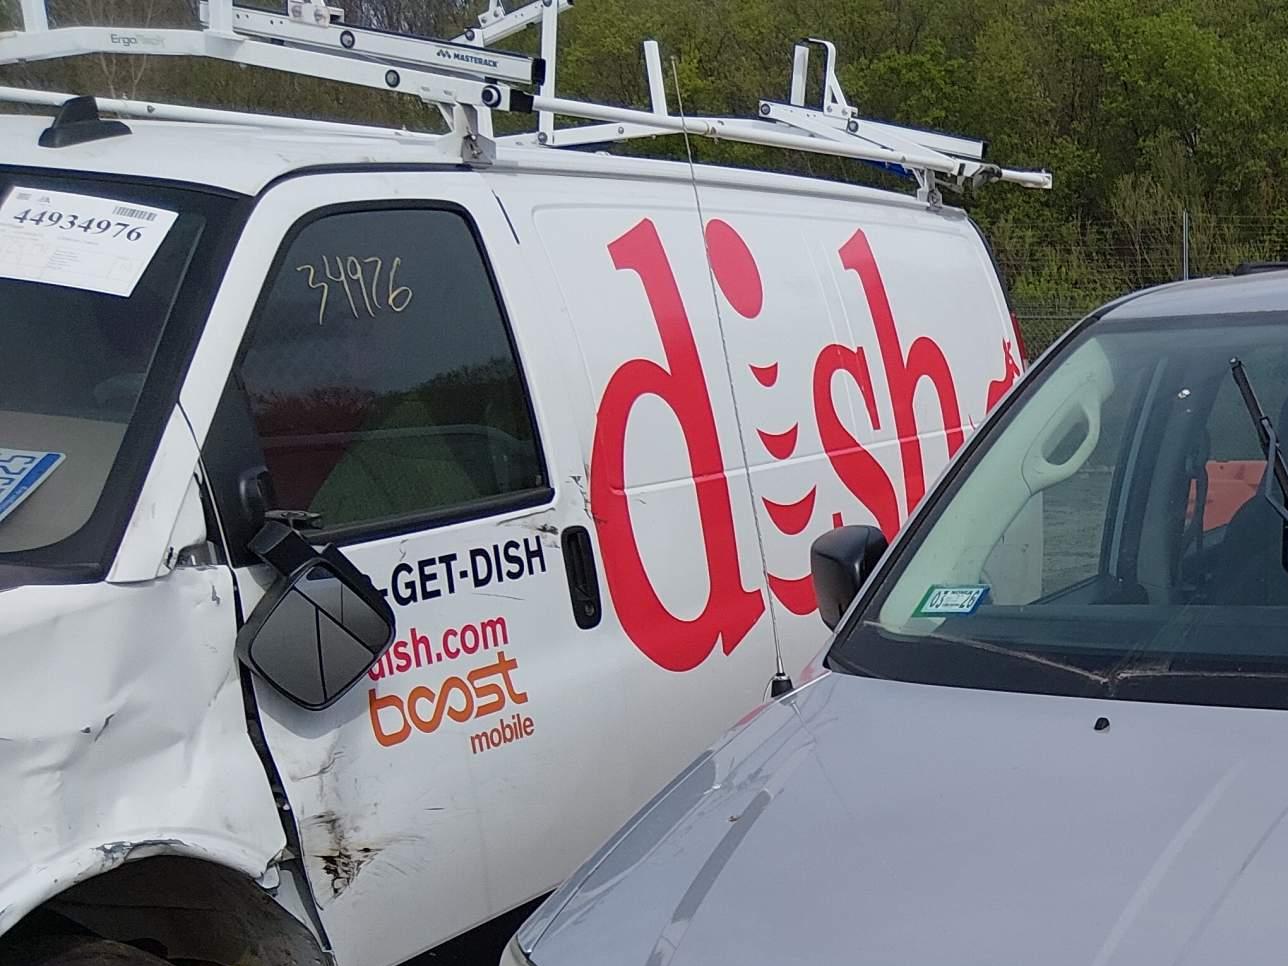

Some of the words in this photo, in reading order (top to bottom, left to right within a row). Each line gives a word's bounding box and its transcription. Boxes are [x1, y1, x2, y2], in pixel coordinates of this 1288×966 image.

[13, 208, 146, 242] 44934976
[296, 255, 412, 325] 34976
[368, 651, 528, 747] boost
[470, 713, 535, 754] mobile
